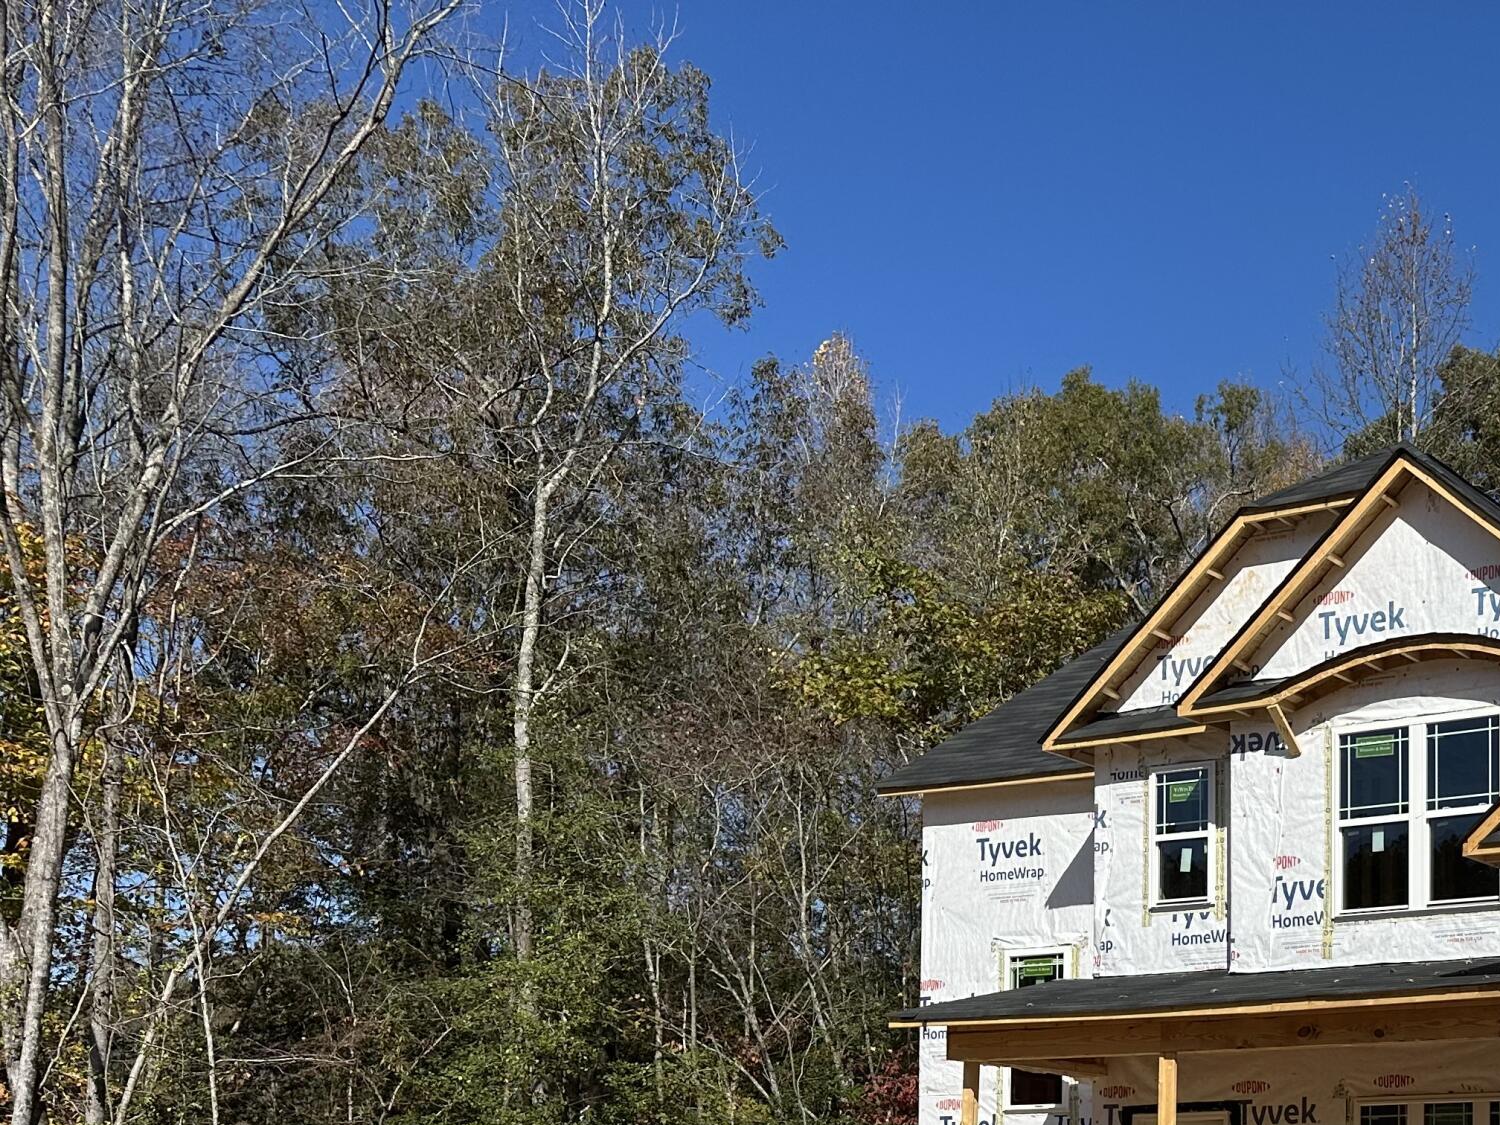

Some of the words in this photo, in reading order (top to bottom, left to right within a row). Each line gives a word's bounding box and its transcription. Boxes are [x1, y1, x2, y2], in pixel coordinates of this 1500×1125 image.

[1319, 602, 1405, 645] Tyvek
[976, 833, 1042, 866] Tyvek
[980, 866, 1044, 883] HomeWrap
[1236, 1080, 1267, 1094] DUPONT
[1378, 1074, 1411, 1089] DUPONT
